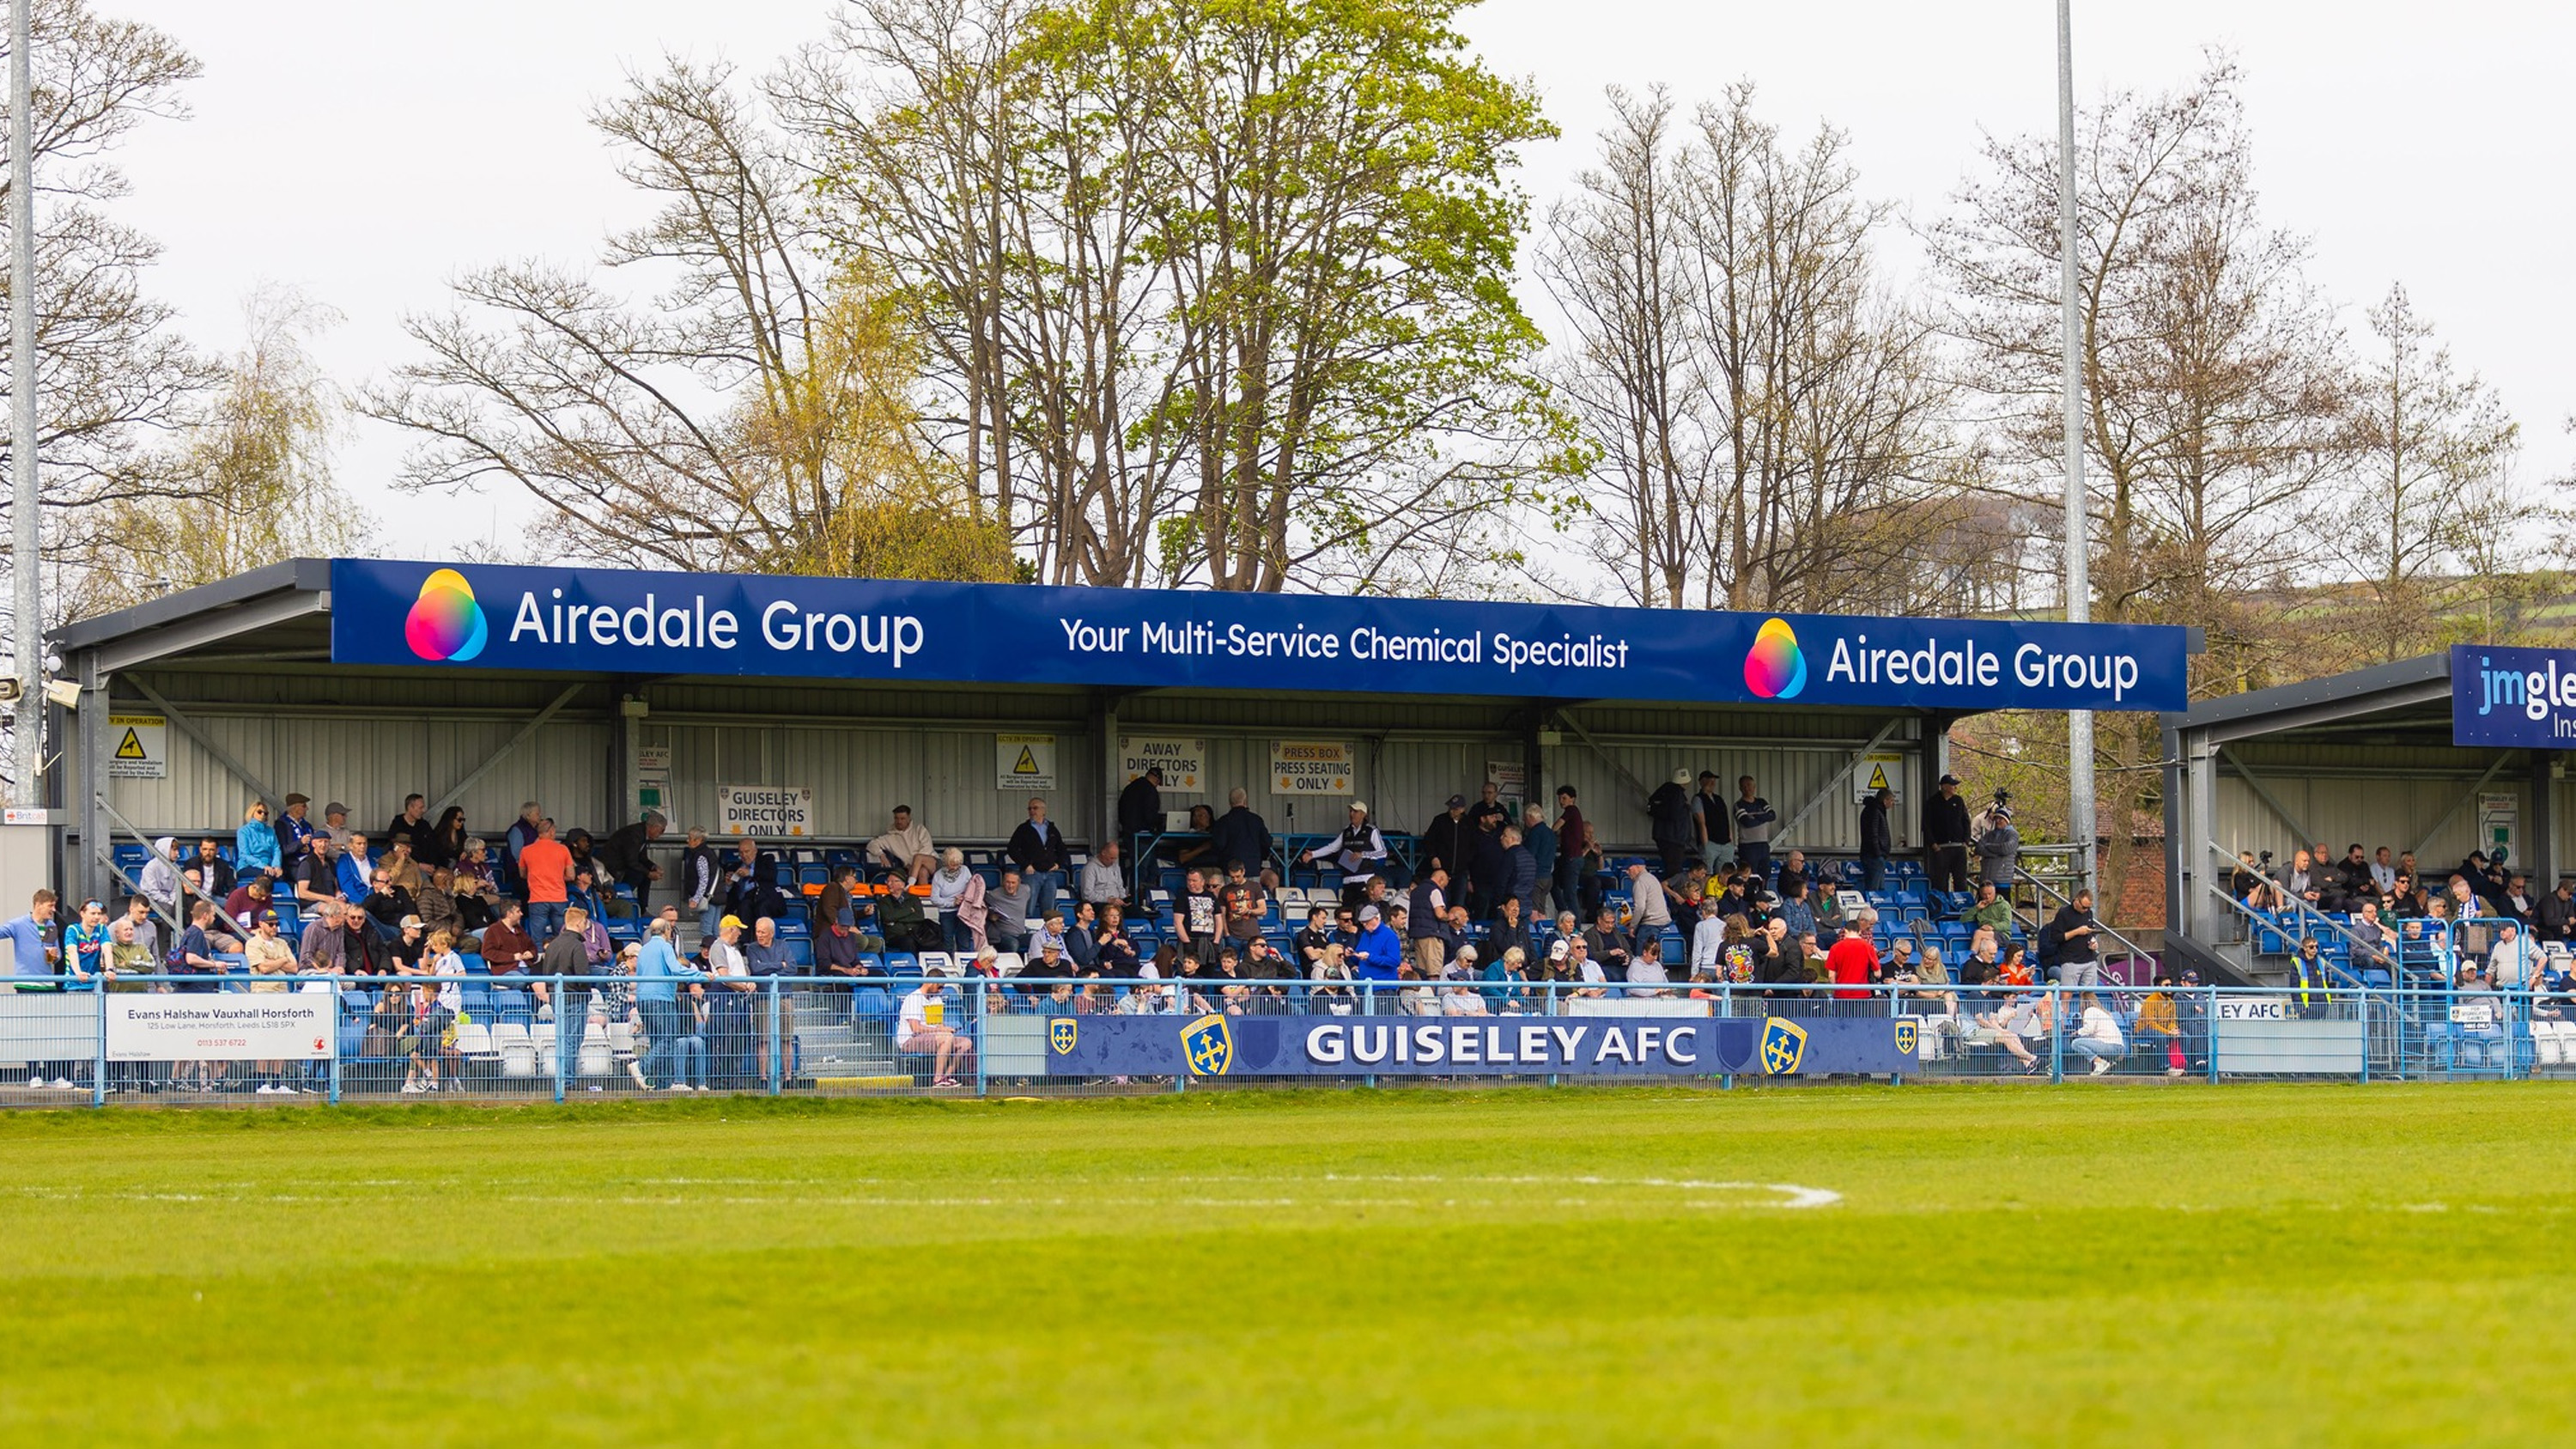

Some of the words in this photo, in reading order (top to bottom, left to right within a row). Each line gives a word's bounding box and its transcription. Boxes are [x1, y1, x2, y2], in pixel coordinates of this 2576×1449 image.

[509, 588, 738, 649] Airedale
[762, 600, 924, 667] Group
[1060, 618, 1130, 652] Your
[1143, 620, 1340, 658] Multi-Service
[1350, 626, 1481, 663] Chemical
[1492, 633, 1628, 673] Specialist
[1826, 634, 2000, 686] Airedale
[2014, 642, 2139, 702] Group
[1143, 743, 1182, 756] AWAY
[1285, 748, 1315, 758] PRESS
[1319, 748, 1340, 758] BOX
[1127, 758, 1197, 772] DIRECTORS
[1274, 762, 1305, 774] PRESS
[1309, 762, 1351, 775] SEATING
[1160, 775, 1179, 787] LY
[1297, 777, 1329, 789] ONLY
[732, 792, 799, 806] GUISELEY
[728, 808, 805, 822] DIRECTORS
[748, 825, 786, 836] ONLY
[128, 1009, 161, 1020] Evans
[164, 1009, 210, 1020] Halshaw
[212, 1008, 258, 1019] Vauxhall
[262, 1008, 314, 1019] Horsforth
[2217, 1004, 2243, 1018] EY
[2249, 1004, 2279, 1018] AFC
[1306, 1025, 1589, 1063] GUISELEY
[1595, 1026, 1698, 1063] AFC
